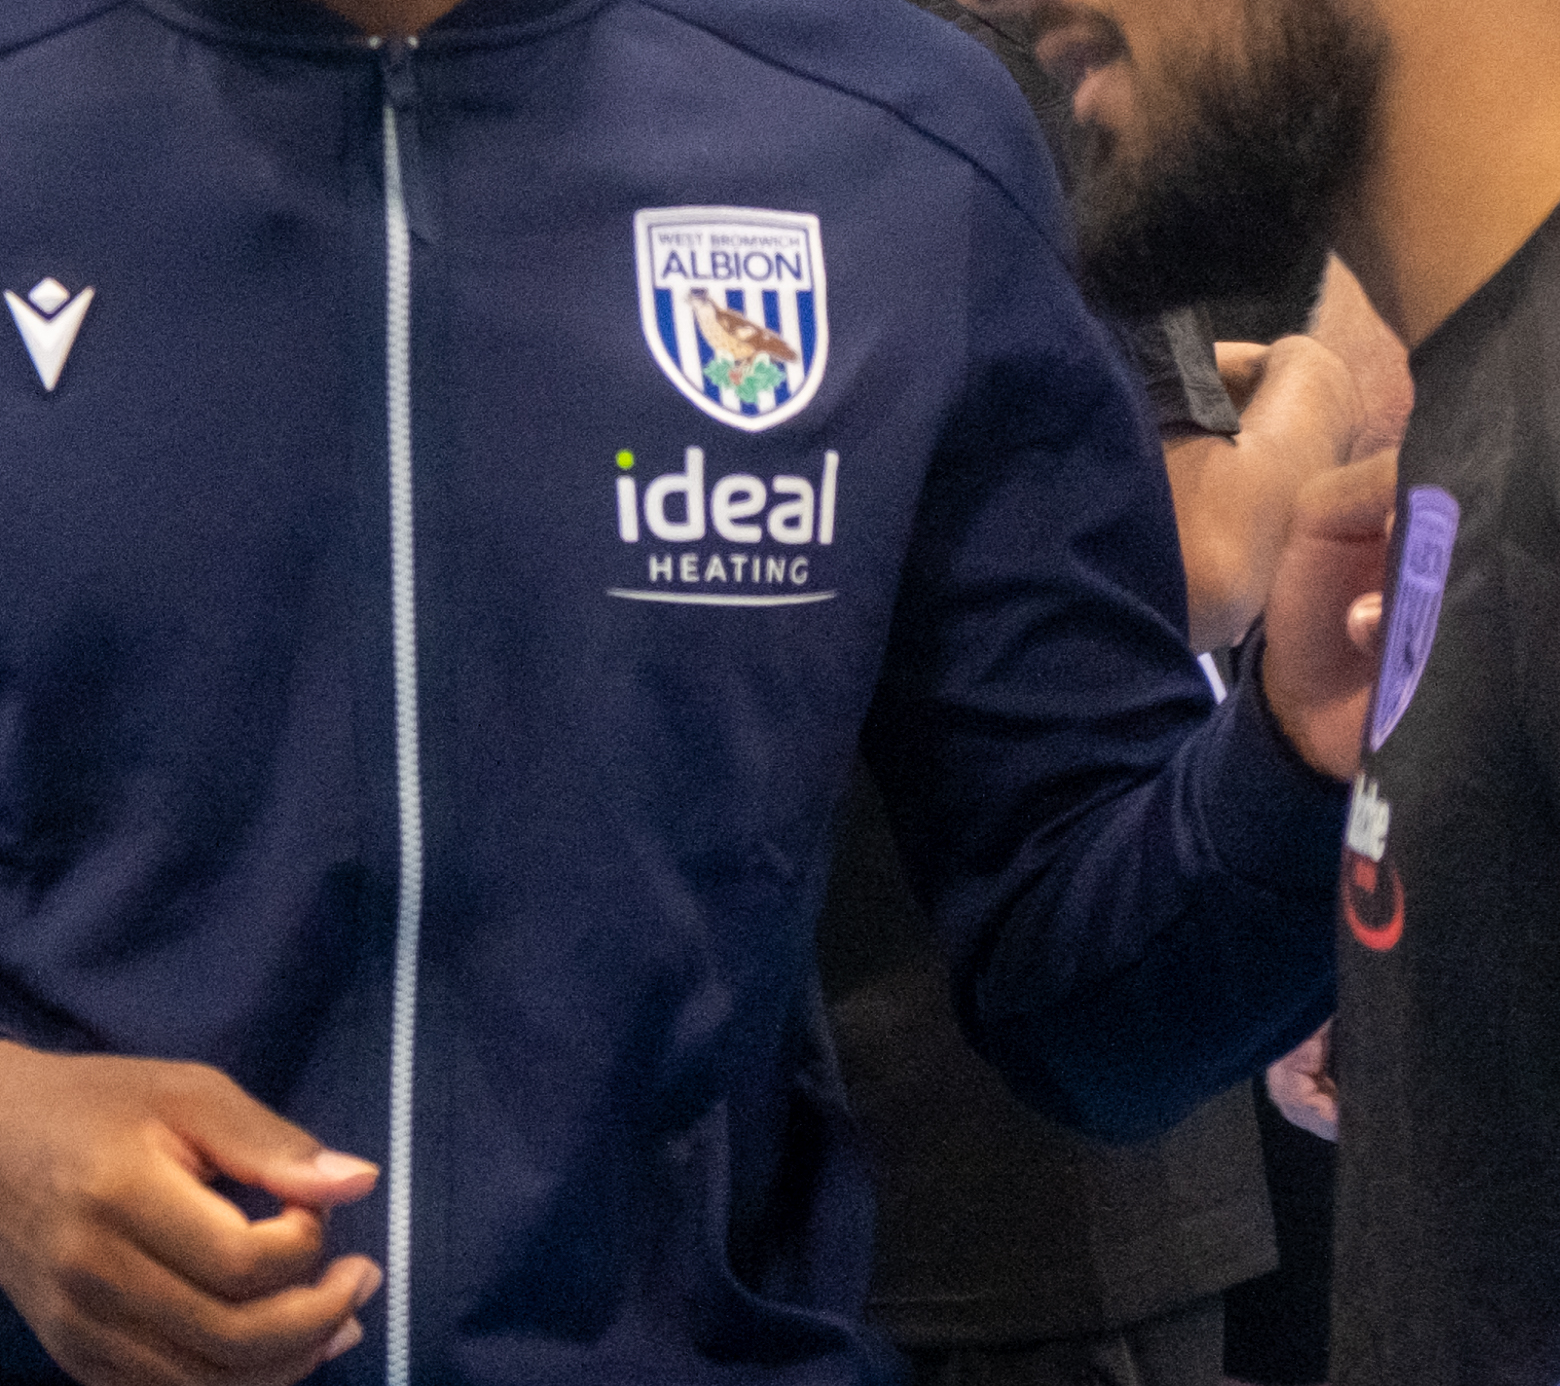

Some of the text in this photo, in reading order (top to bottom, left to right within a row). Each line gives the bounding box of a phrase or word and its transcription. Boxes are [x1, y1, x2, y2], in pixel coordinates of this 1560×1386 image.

[662, 250, 802, 281] ALBION
[615, 447, 840, 545] ideal
[648, 553, 810, 584] HEATING
